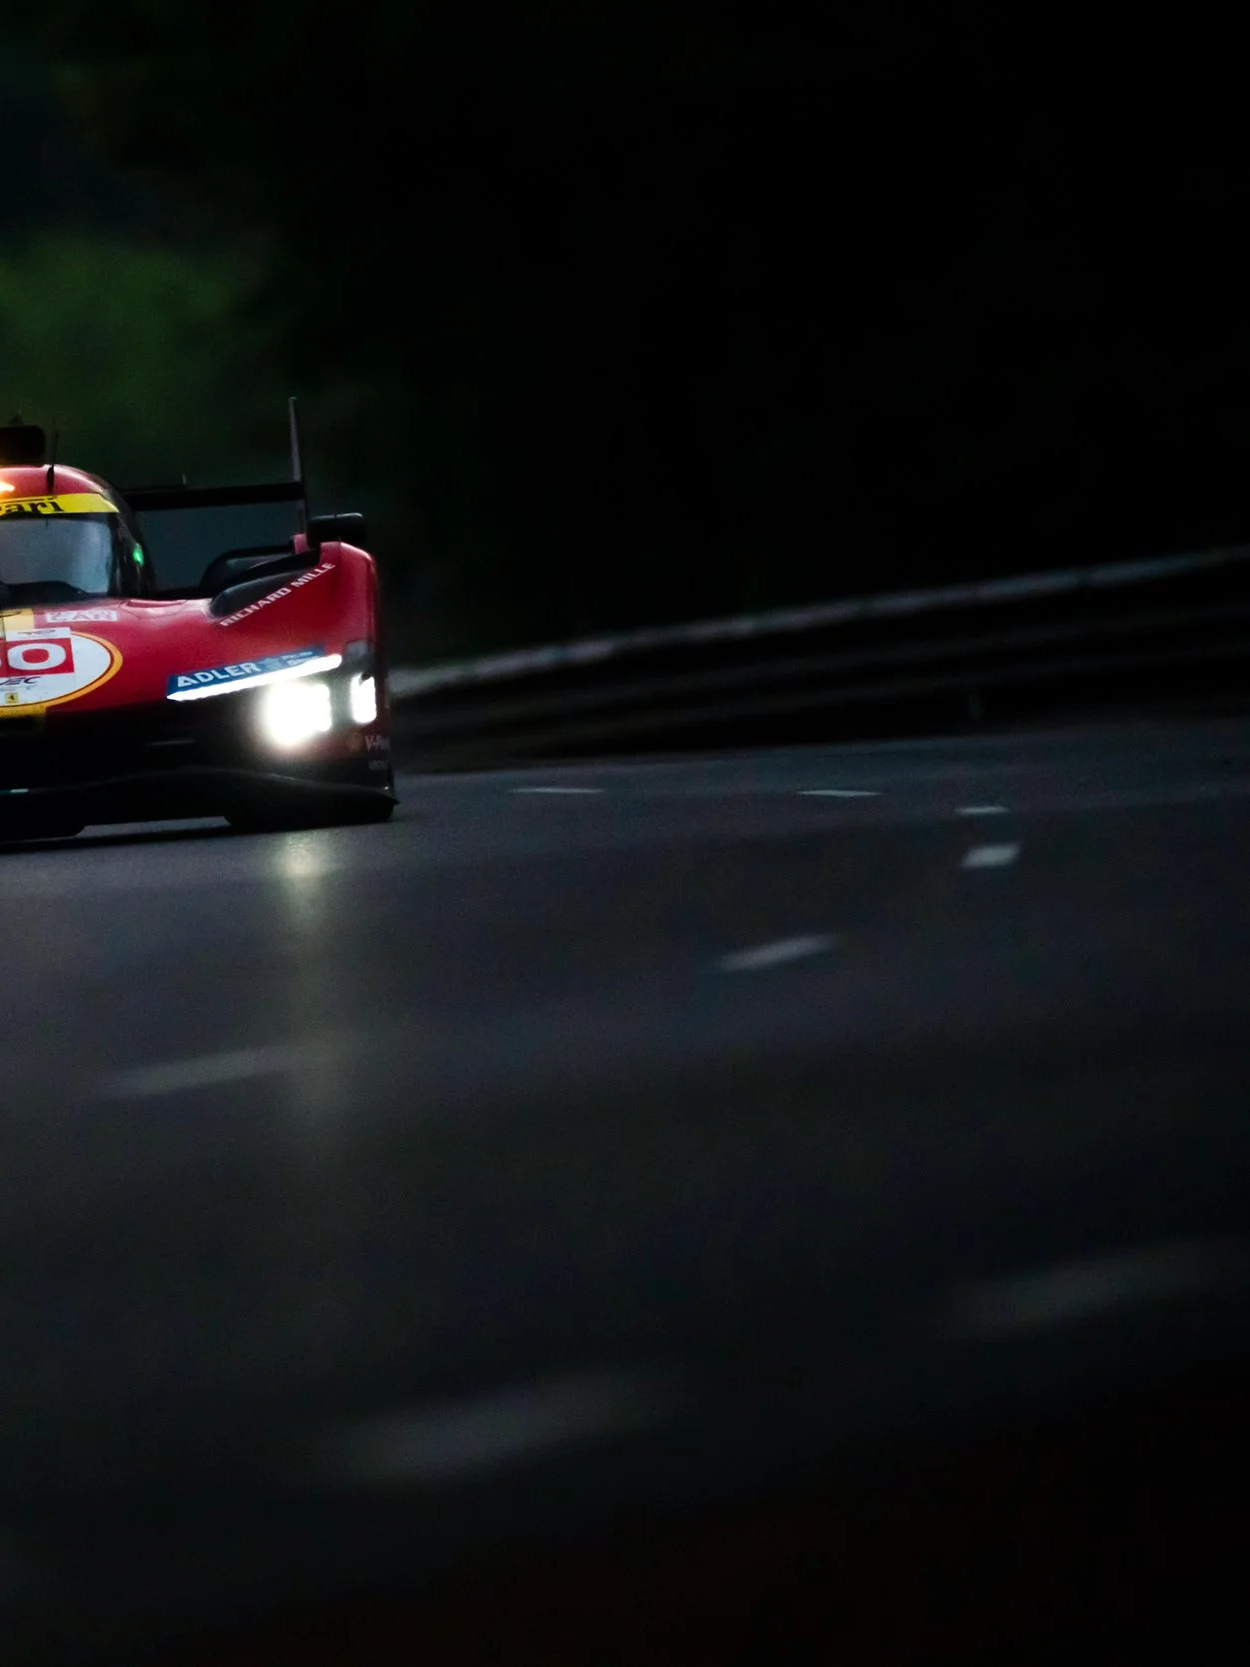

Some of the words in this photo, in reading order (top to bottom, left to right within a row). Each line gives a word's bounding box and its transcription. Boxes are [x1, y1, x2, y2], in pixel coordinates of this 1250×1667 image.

[219, 587, 292, 627] RICHARD
[290, 562, 336, 588] MILLE
[177, 662, 262, 688] ADLER
